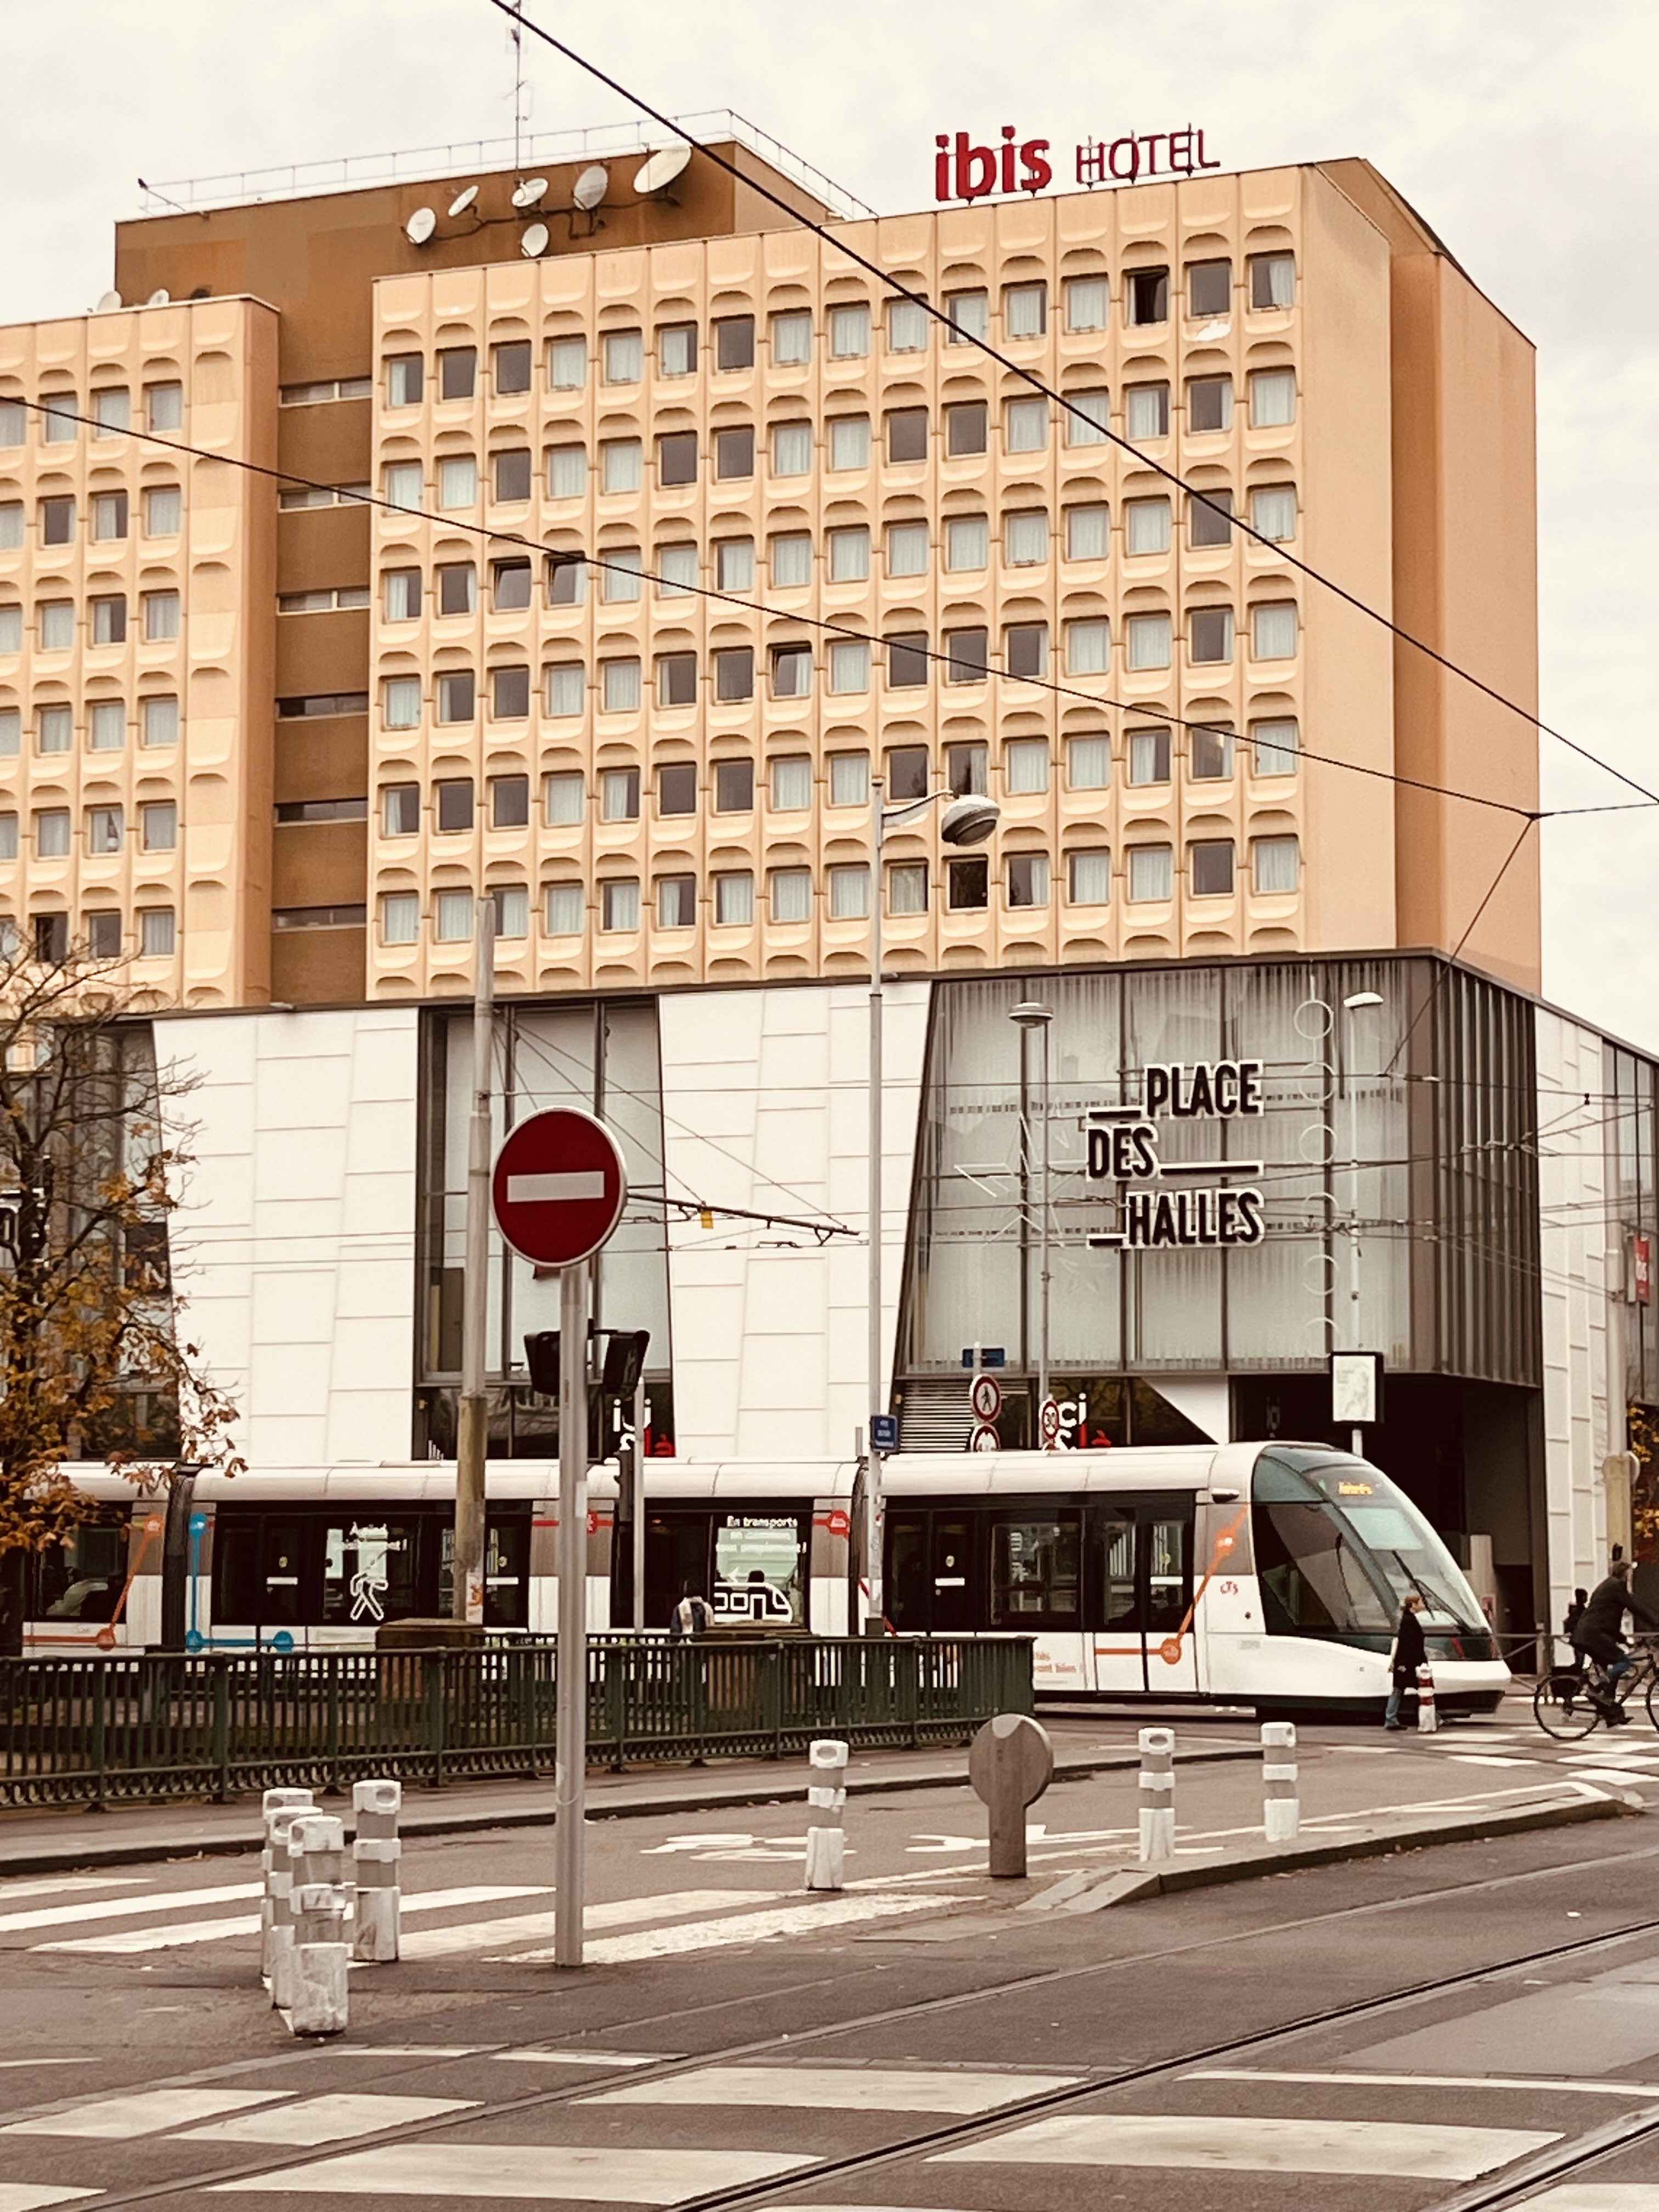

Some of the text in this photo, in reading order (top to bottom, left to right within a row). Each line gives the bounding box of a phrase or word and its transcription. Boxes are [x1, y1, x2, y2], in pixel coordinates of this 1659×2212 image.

[935, 125, 1221, 201] ibis HOTEL
[1145, 1060, 1262, 1118] PLACE
[1087, 1124, 1158, 1181] DES
[1127, 1189, 1263, 1247] HALLES
